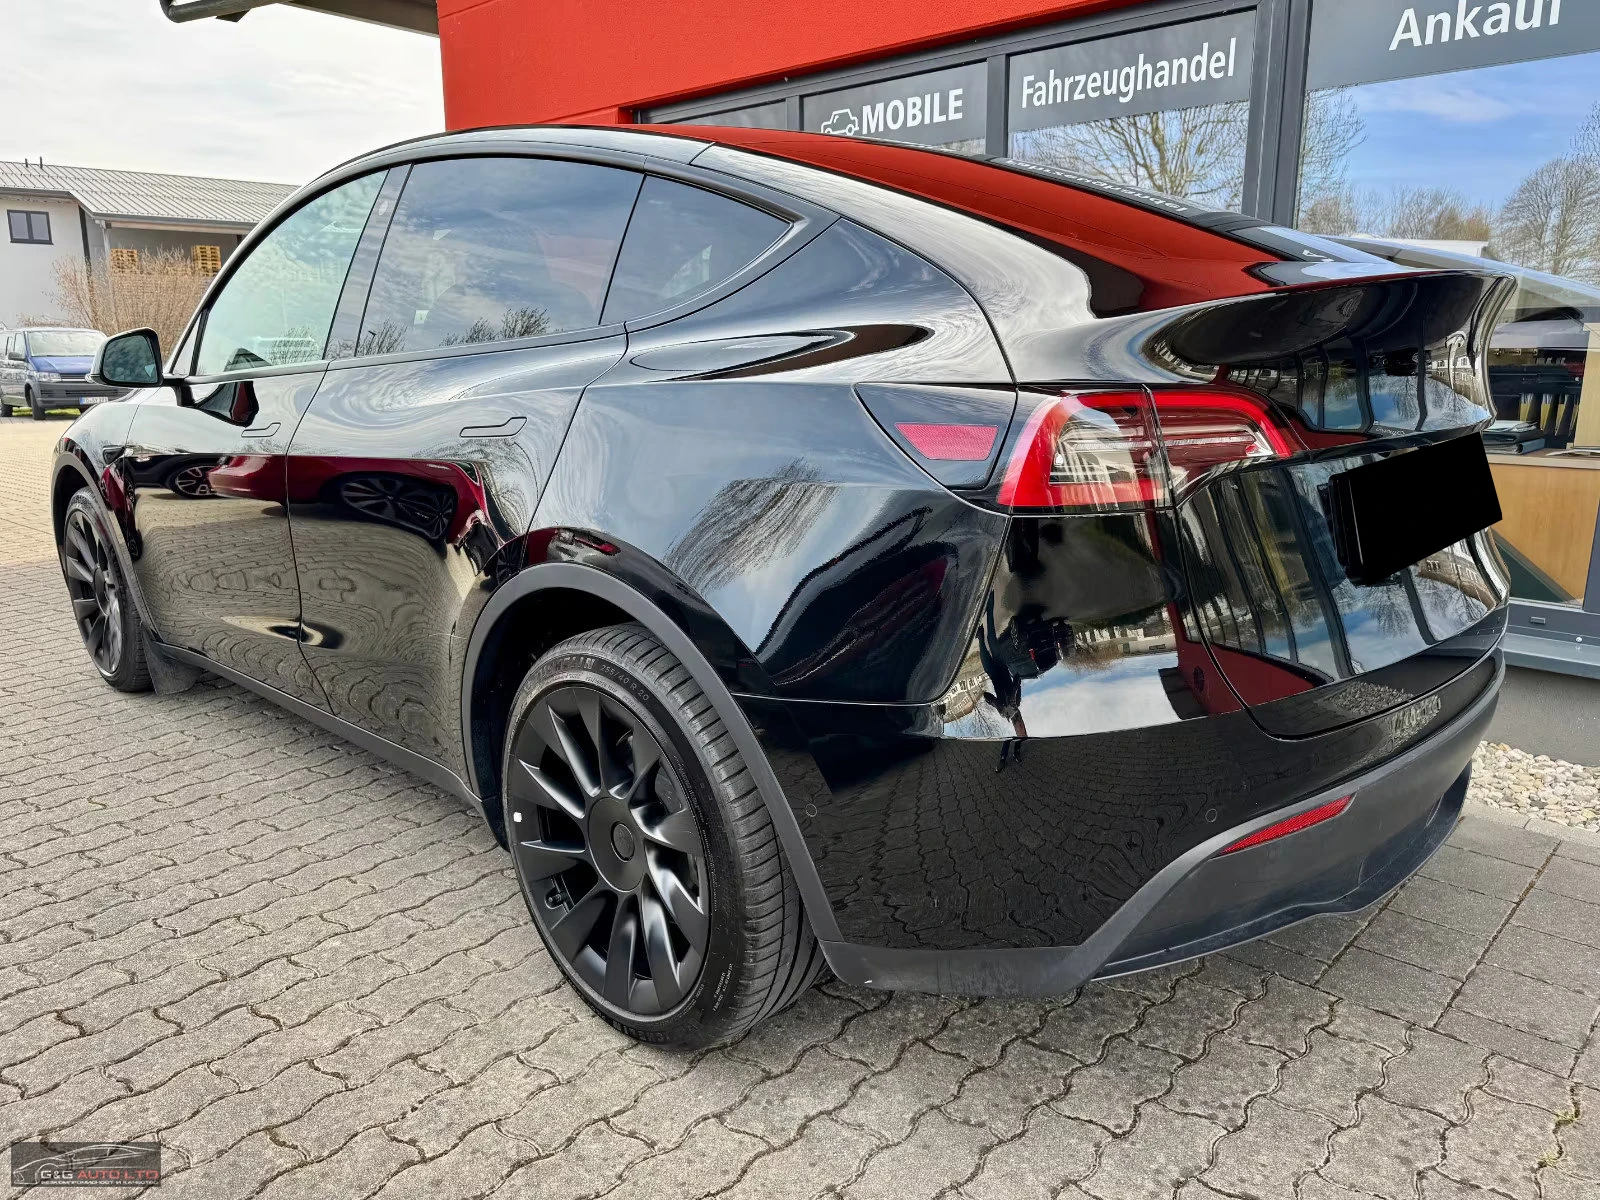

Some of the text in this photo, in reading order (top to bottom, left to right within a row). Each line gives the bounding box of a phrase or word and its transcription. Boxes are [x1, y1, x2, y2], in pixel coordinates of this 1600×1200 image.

[1021, 37, 1236, 108] Fahrzeughandel
[862, 88, 963, 135] MOBILE
[599, 664, 630, 684] 255/40
[637, 688, 650, 701] 20
